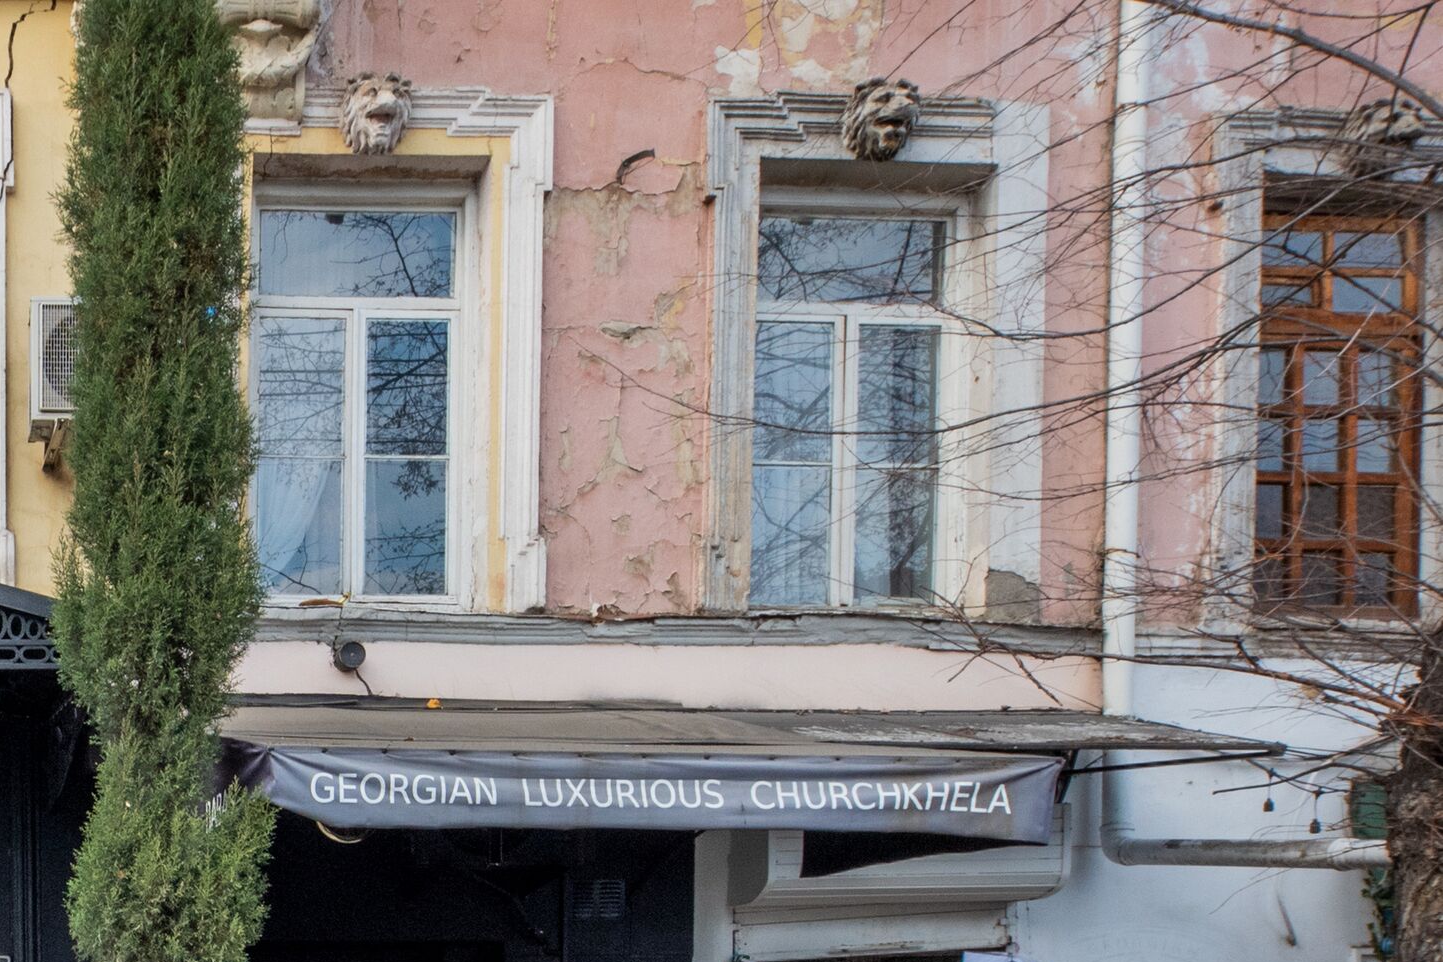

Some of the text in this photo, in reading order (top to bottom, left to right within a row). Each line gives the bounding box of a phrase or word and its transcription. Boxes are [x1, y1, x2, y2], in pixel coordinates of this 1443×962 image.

[310, 772, 1013, 815] GEORGIAN LUXURIOUS CHURCHKHELA
